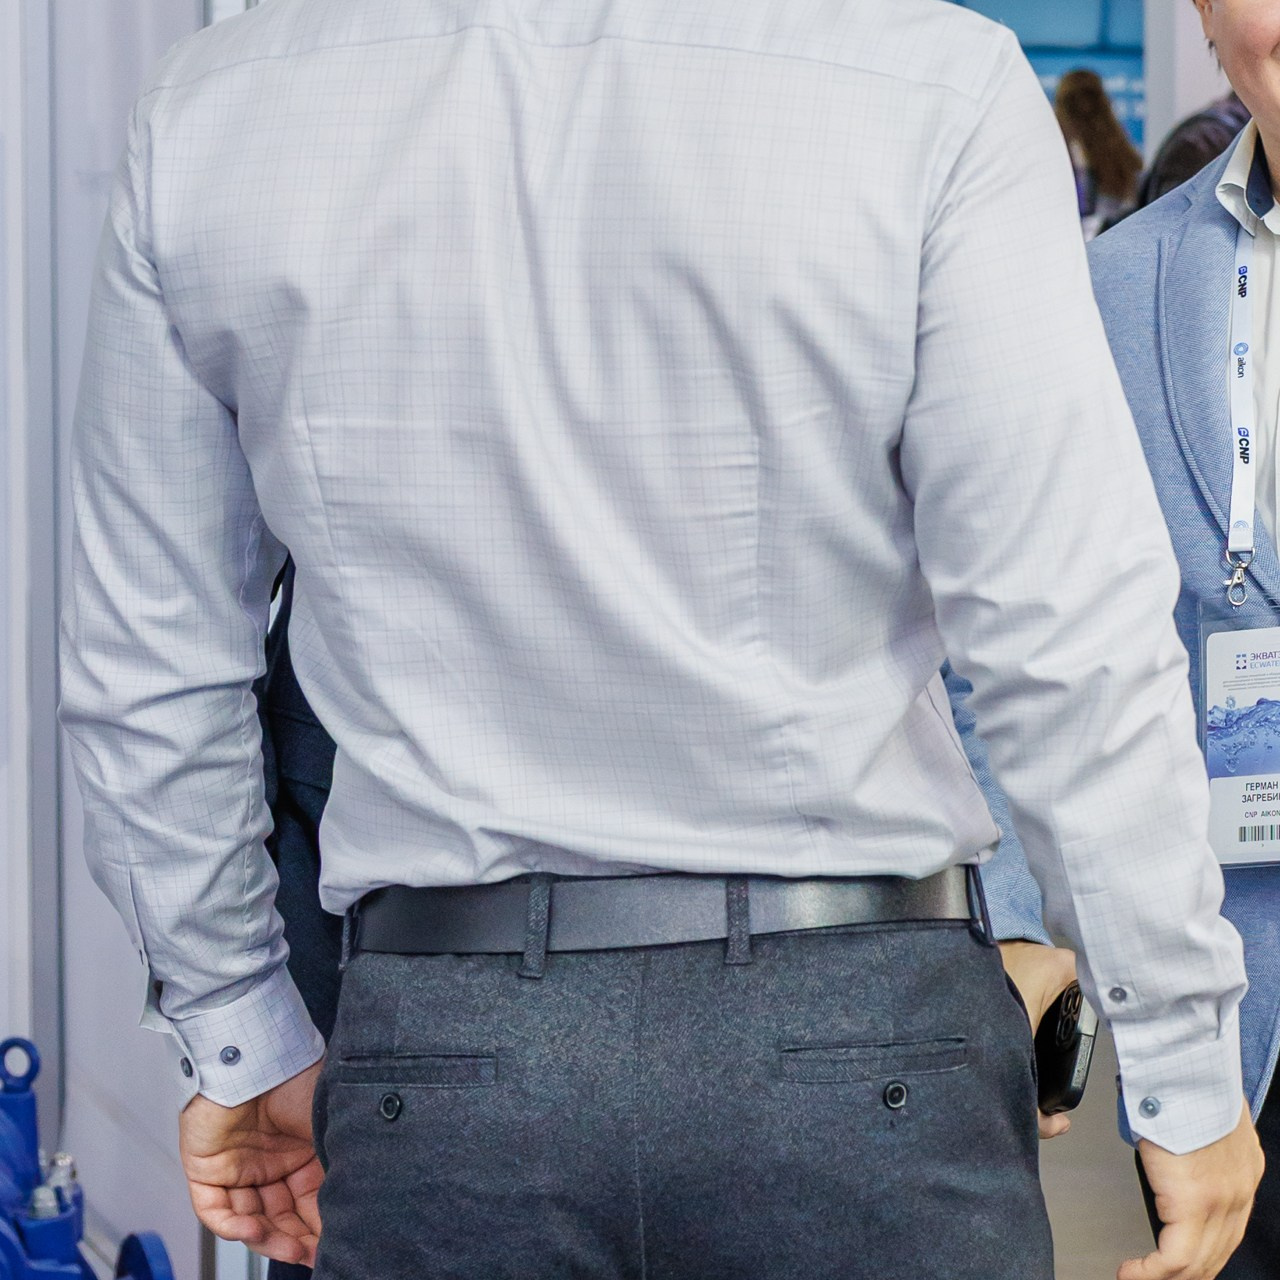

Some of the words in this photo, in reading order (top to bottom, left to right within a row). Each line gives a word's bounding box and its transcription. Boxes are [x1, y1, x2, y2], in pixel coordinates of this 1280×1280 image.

[1238, 275, 1247, 298] CNP
[1239, 438, 1249, 464] CNP
[1245, 781, 1279, 791] ГЕРМАН
